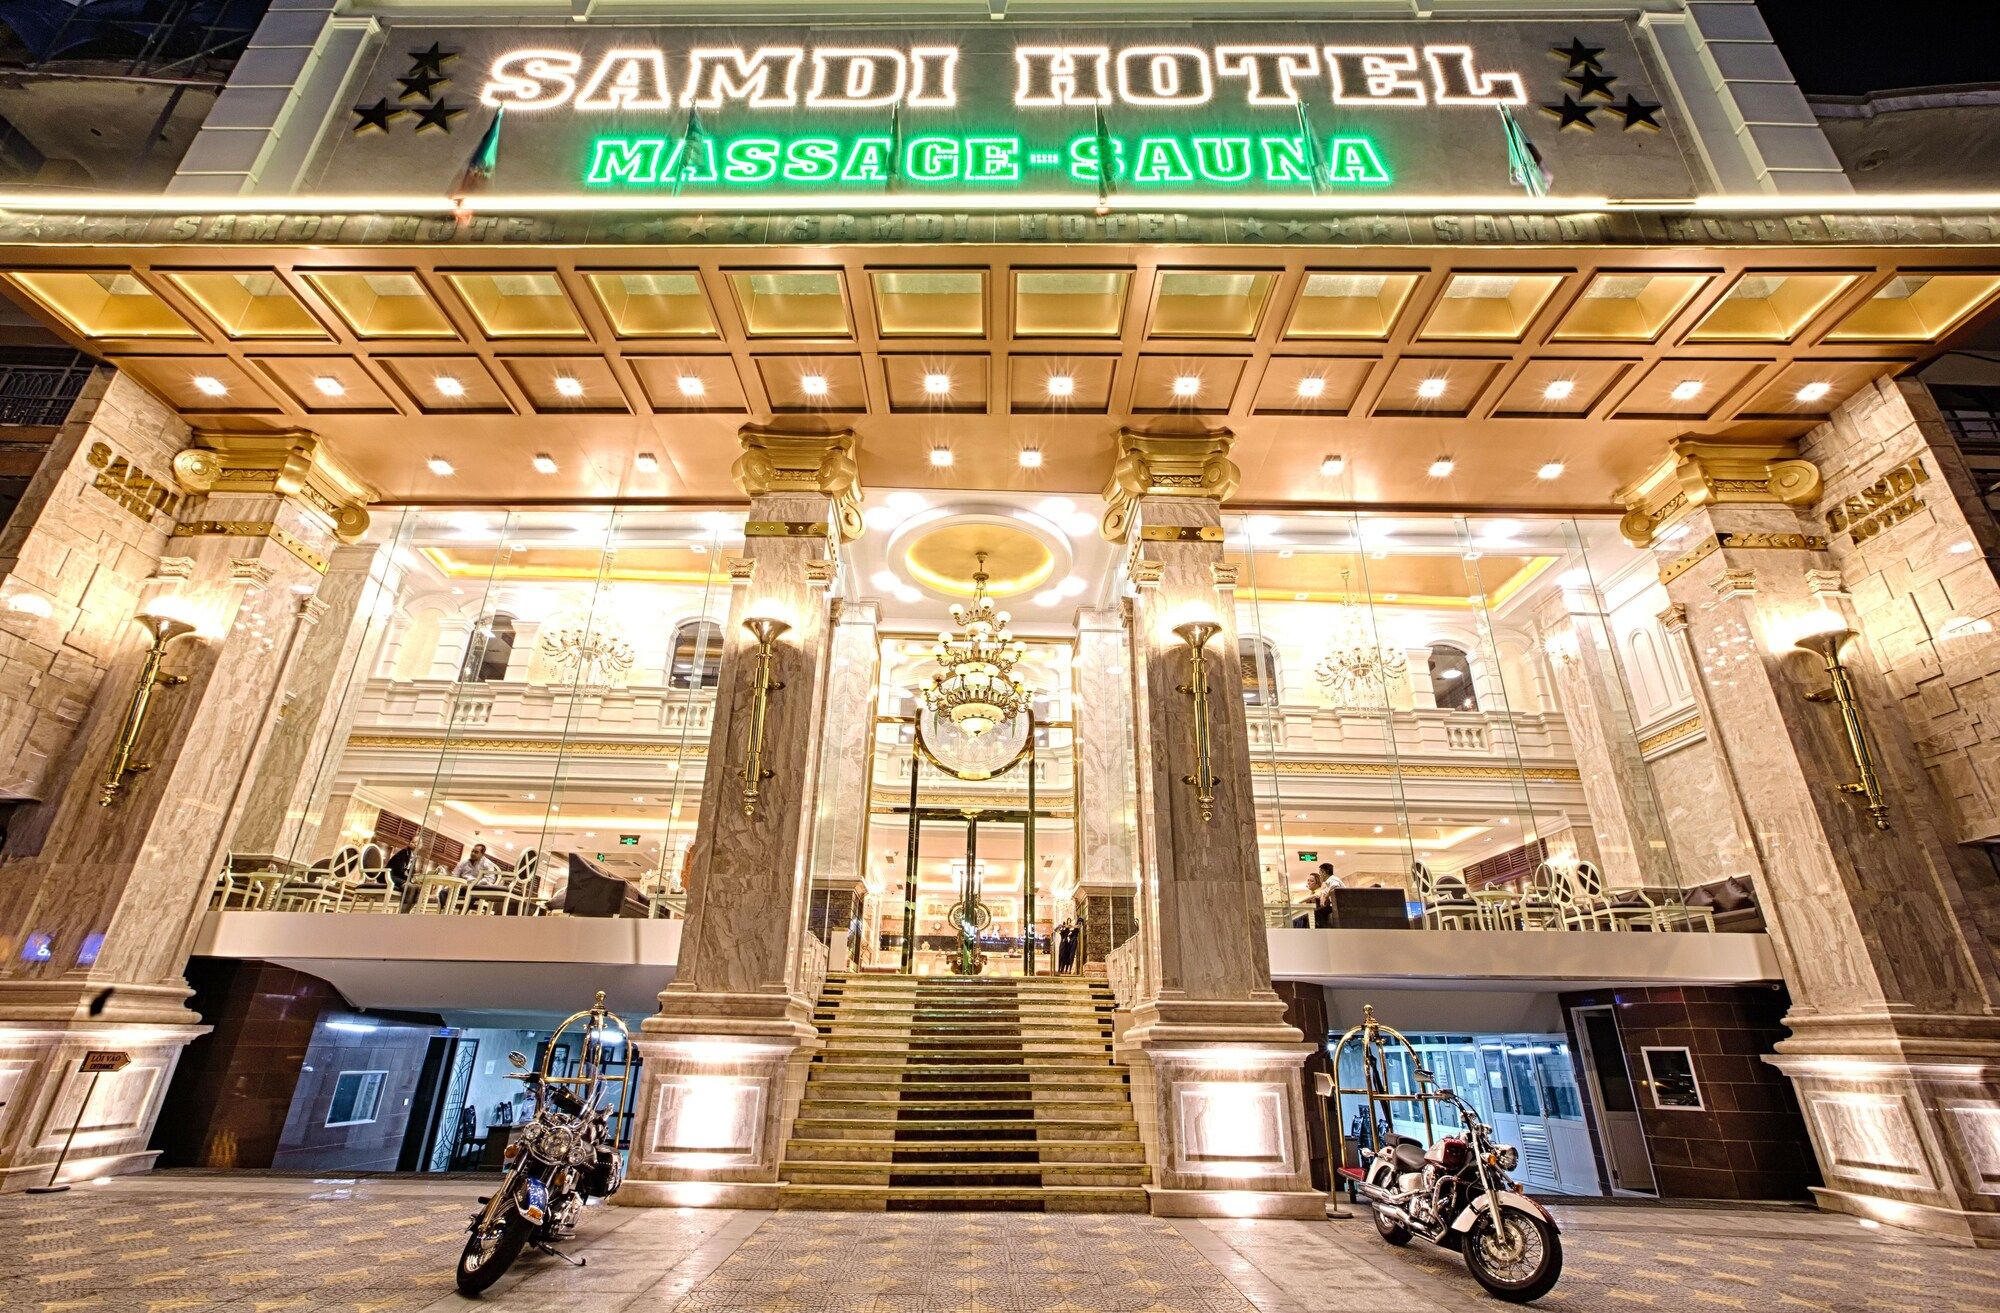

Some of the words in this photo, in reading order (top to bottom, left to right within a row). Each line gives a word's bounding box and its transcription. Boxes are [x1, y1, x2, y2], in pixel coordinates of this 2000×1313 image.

[479, 46, 959, 110] SAMDI
[1014, 45, 1528, 106] HOTEL
[168, 214, 347, 242] SAMDI
[387, 214, 567, 243] HOTEL
[793, 213, 970, 241] SAMDI
[1018, 213, 1201, 241] HOTEL
[1432, 214, 1610, 242] SAMDI
[1659, 214, 1858, 242] HOTEL
[87, 441, 180, 517] SAMDI
[92, 472, 156, 524] HOTEL
[1824, 456, 1930, 534] SAMDI
[1848, 495, 1926, 549] HOTEL
